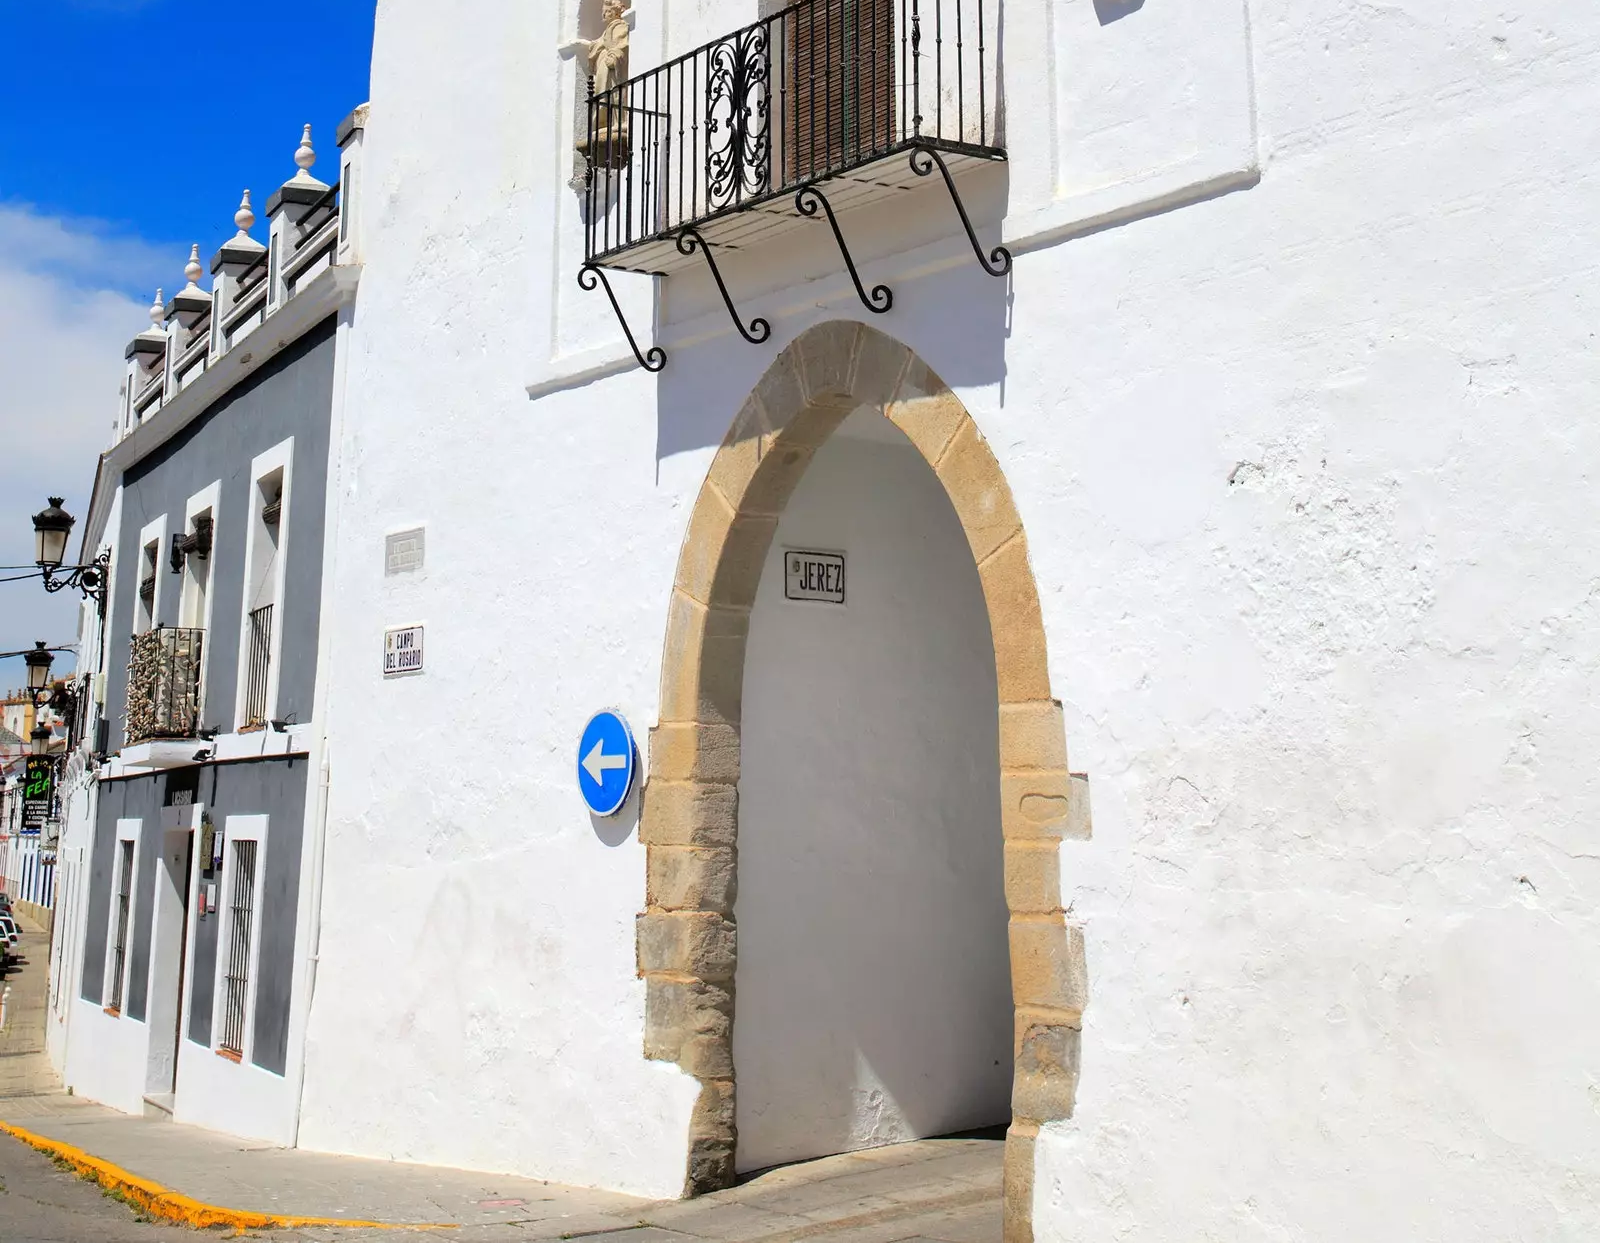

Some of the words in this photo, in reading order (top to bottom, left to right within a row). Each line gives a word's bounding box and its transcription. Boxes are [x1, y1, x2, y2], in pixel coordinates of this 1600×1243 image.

[800, 561, 841, 593] JEREZ
[397, 632, 414, 649] CAMPO
[386, 652, 396, 669] DEL
[398, 649, 421, 667] ROSARIO
[31, 771, 42, 779] LA
